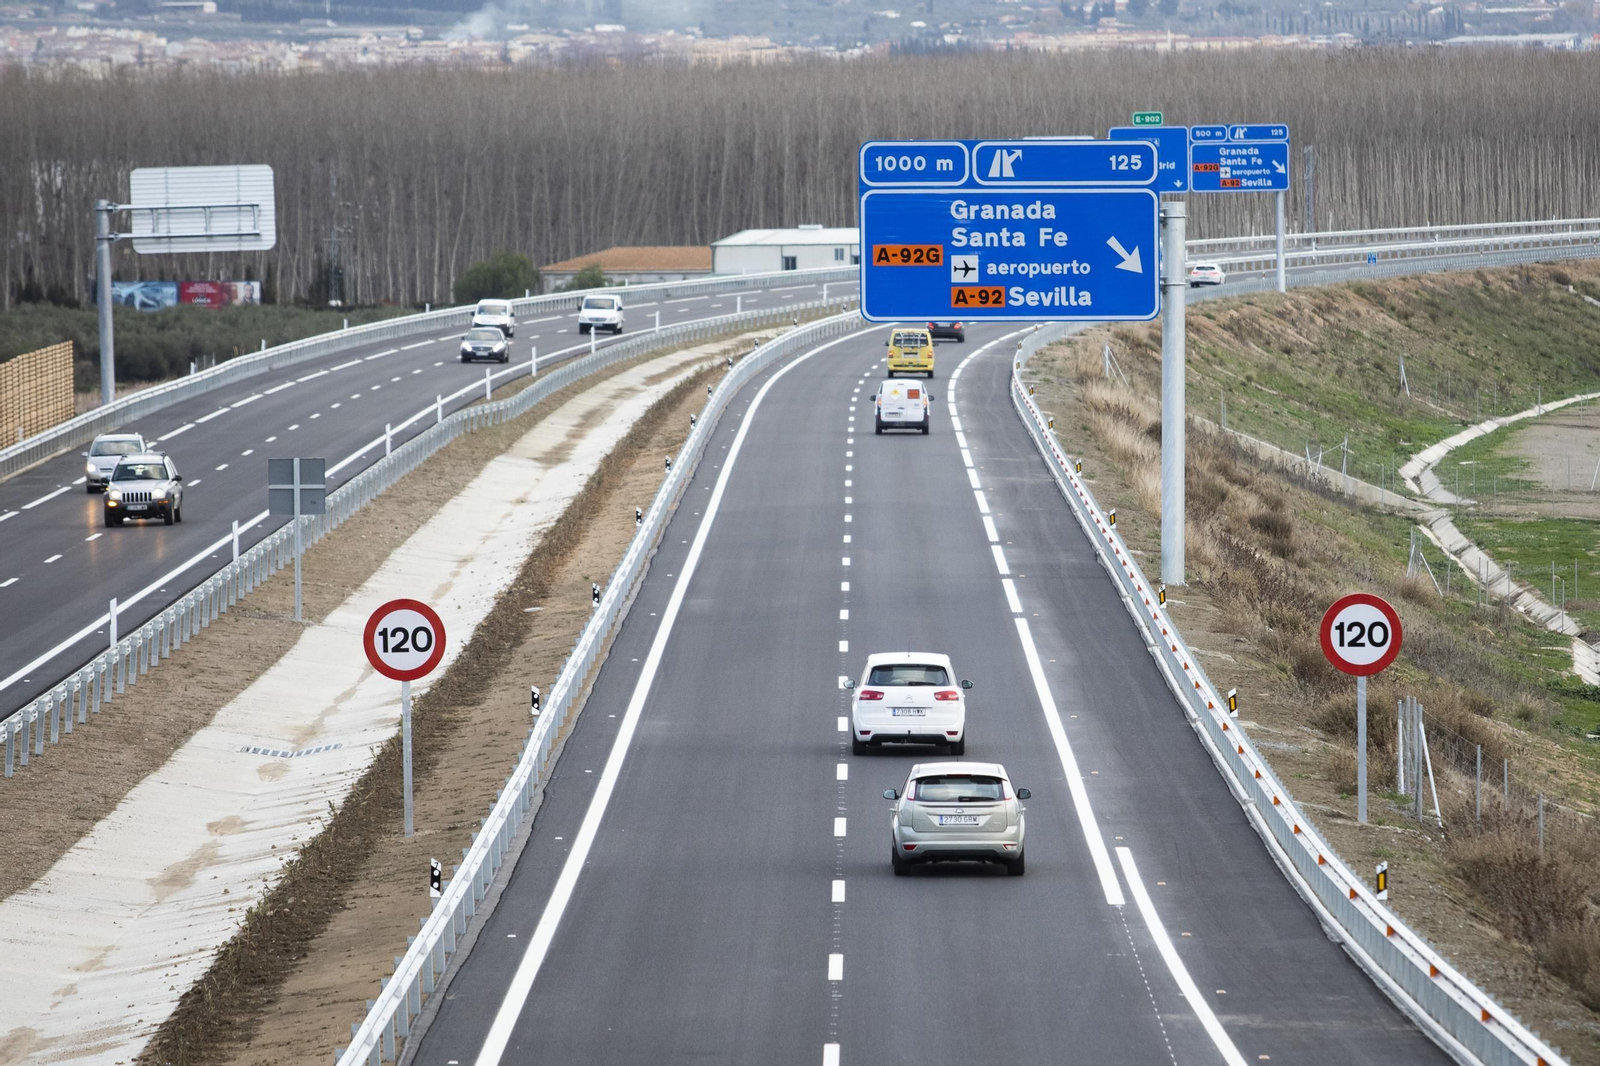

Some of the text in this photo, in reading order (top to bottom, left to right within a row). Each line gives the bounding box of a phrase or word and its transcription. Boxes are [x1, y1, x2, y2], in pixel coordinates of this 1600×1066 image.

[1271, 128, 1284, 136] 125
[1219, 147, 1259, 156] Granada
[875, 156, 954, 171] 1000 m
[1109, 155, 1142, 171] 125
[1220, 157, 1263, 165] Santa Fe
[1241, 178, 1272, 187] Sevilla
[950, 200, 1056, 220] Granada
[951, 227, 1068, 247] Santa Fe
[876, 247, 941, 264] A-92G
[986, 261, 1091, 278] aeropuerto
[954, 286, 1092, 307] A-92 Sevilla
[378, 626, 433, 653] 120
[1335, 621, 1389, 647] 120
[944, 815, 962, 823] 2730
